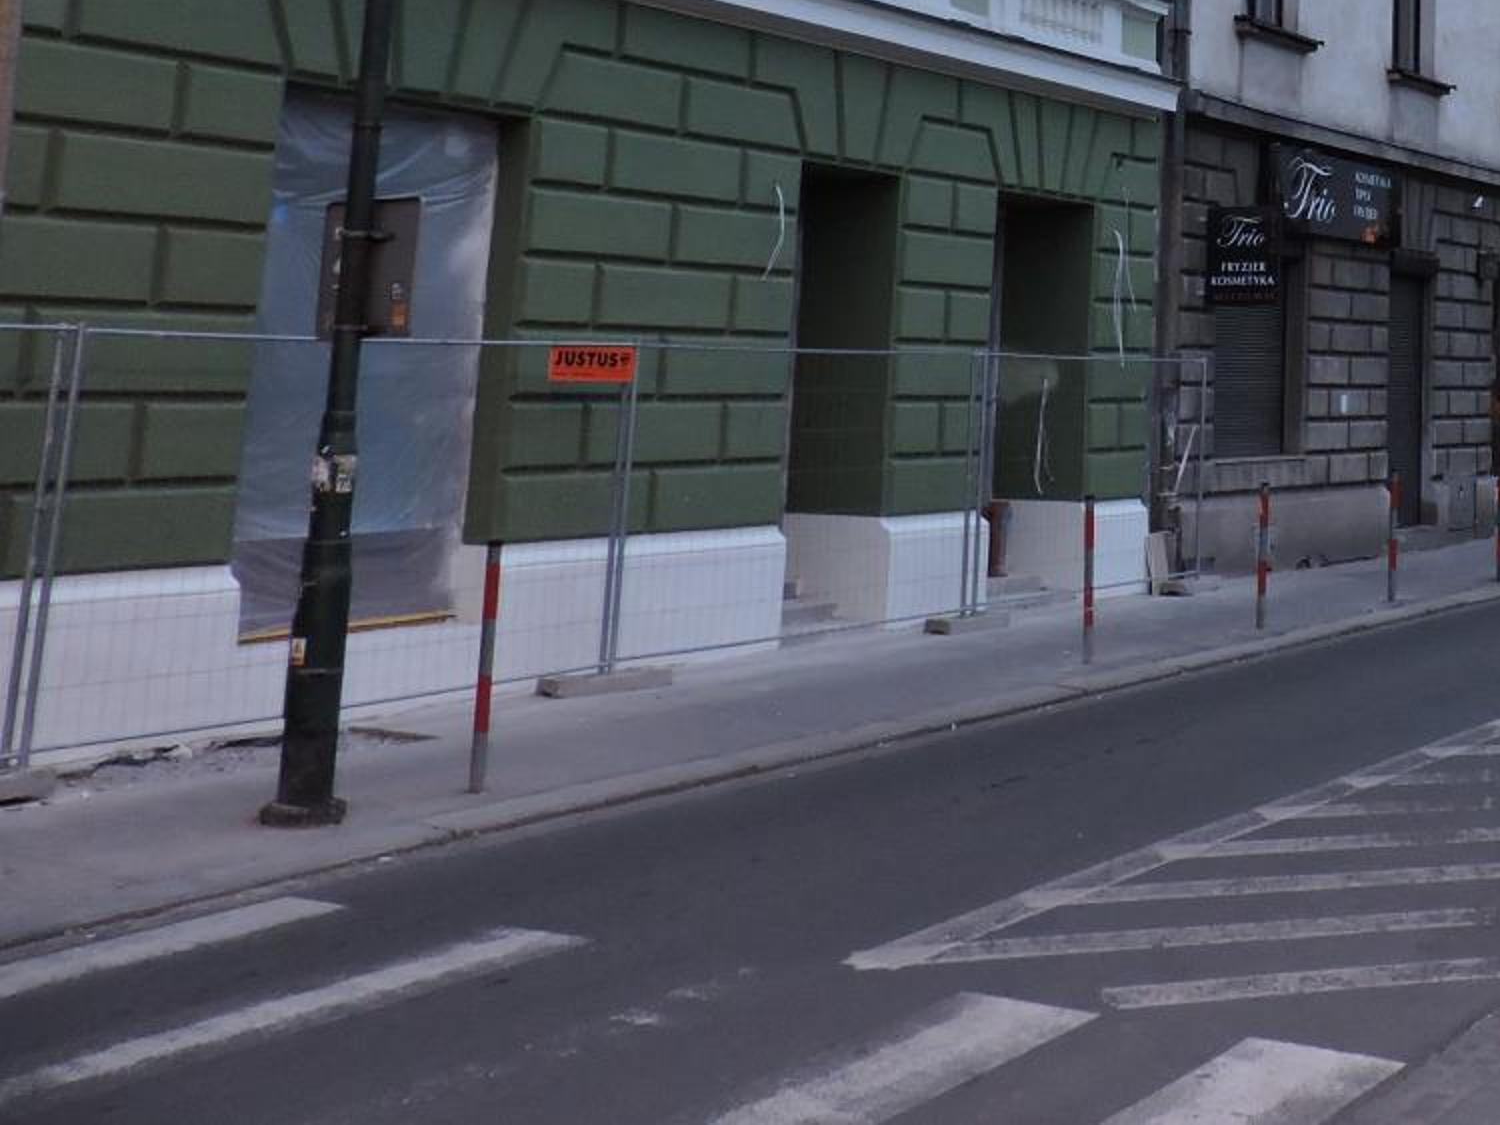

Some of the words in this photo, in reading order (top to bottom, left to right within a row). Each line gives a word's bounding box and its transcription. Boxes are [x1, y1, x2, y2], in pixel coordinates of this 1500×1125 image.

[1282, 156, 1337, 223] Trio
[1216, 216, 1265, 248] Trio
[555, 350, 618, 367] JUSTUS
